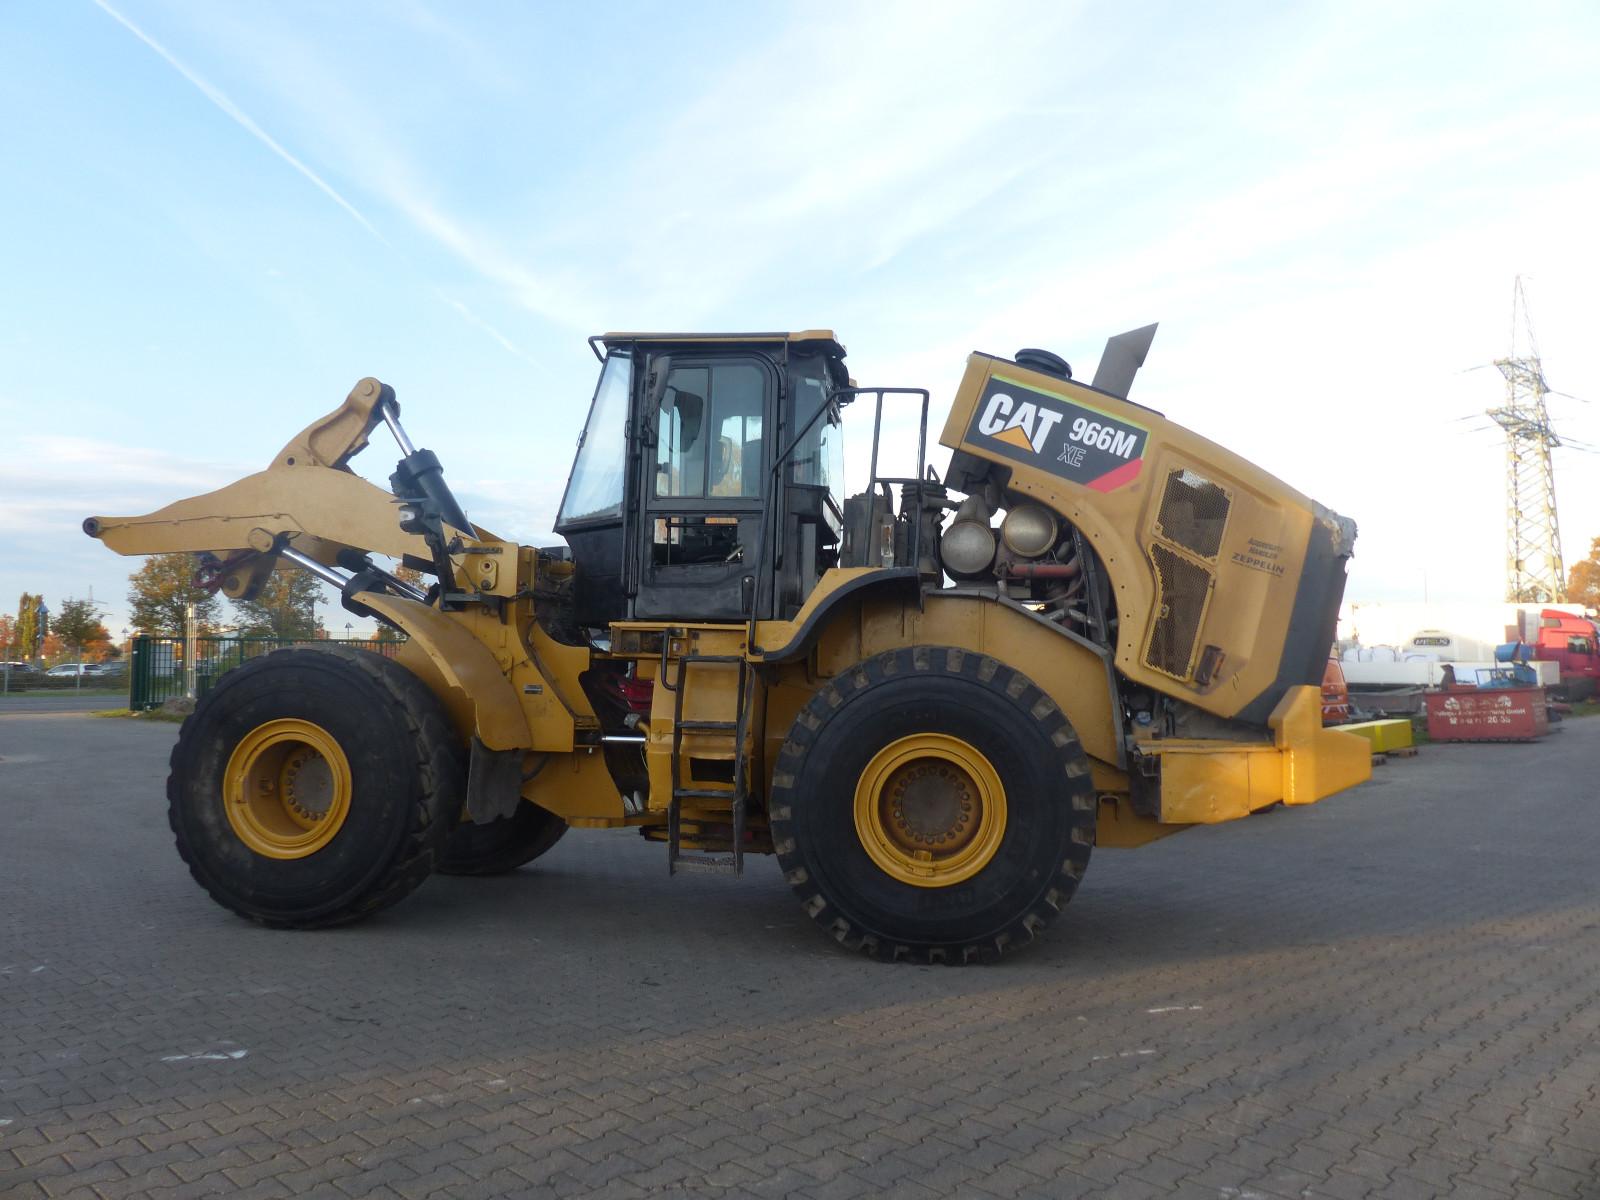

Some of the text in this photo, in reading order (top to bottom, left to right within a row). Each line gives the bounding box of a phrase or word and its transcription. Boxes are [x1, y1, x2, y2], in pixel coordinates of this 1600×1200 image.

[978, 393, 1063, 454] CAT
[1069, 417, 1137, 459] 966M
[1057, 443, 1087, 467] XE
[1231, 552, 1285, 573] ZEPPELIN
